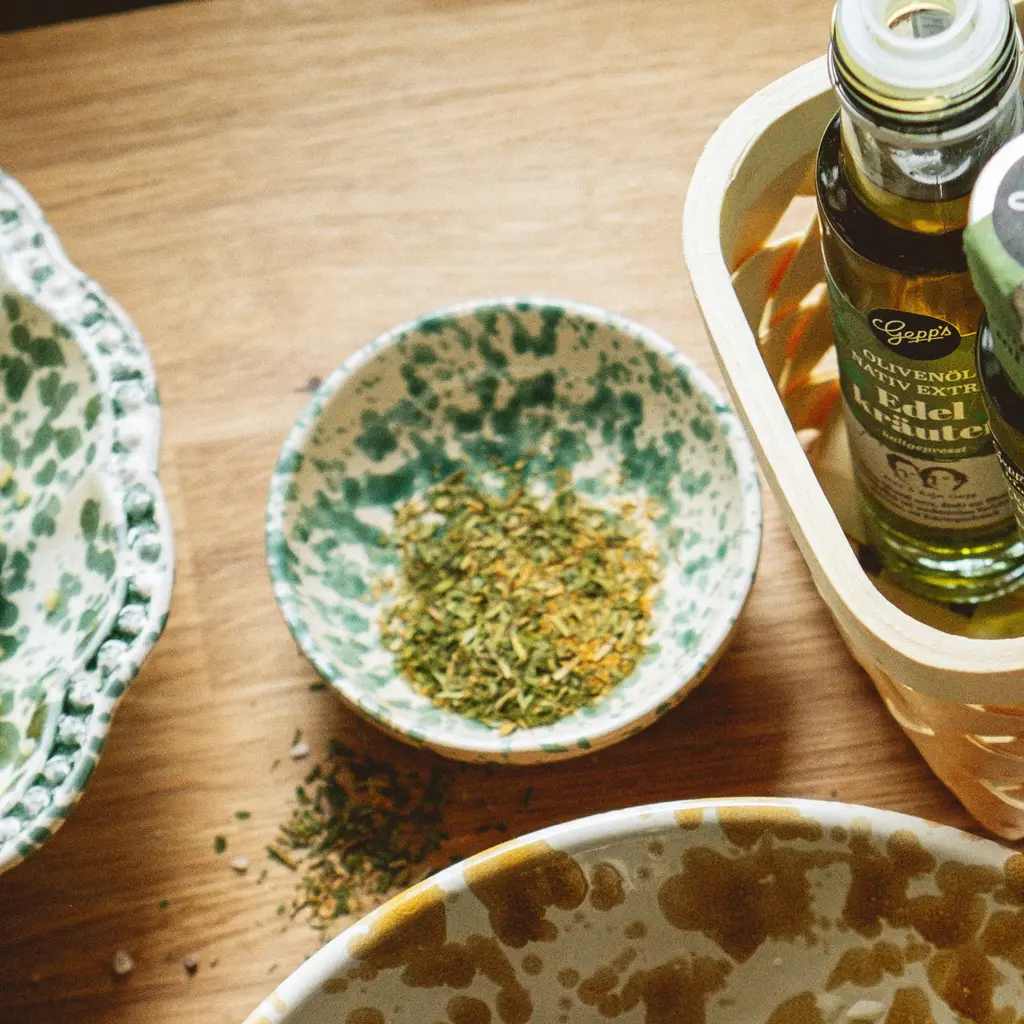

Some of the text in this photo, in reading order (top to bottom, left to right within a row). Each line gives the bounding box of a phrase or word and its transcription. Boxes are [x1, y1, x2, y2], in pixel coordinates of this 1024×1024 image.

[872, 318, 952, 346] Gepp's
[851, 349, 980, 397] NATIV EXTR
[863, 348, 977, 383] OLIVENÖL
[876, 385, 968, 421] Edel
